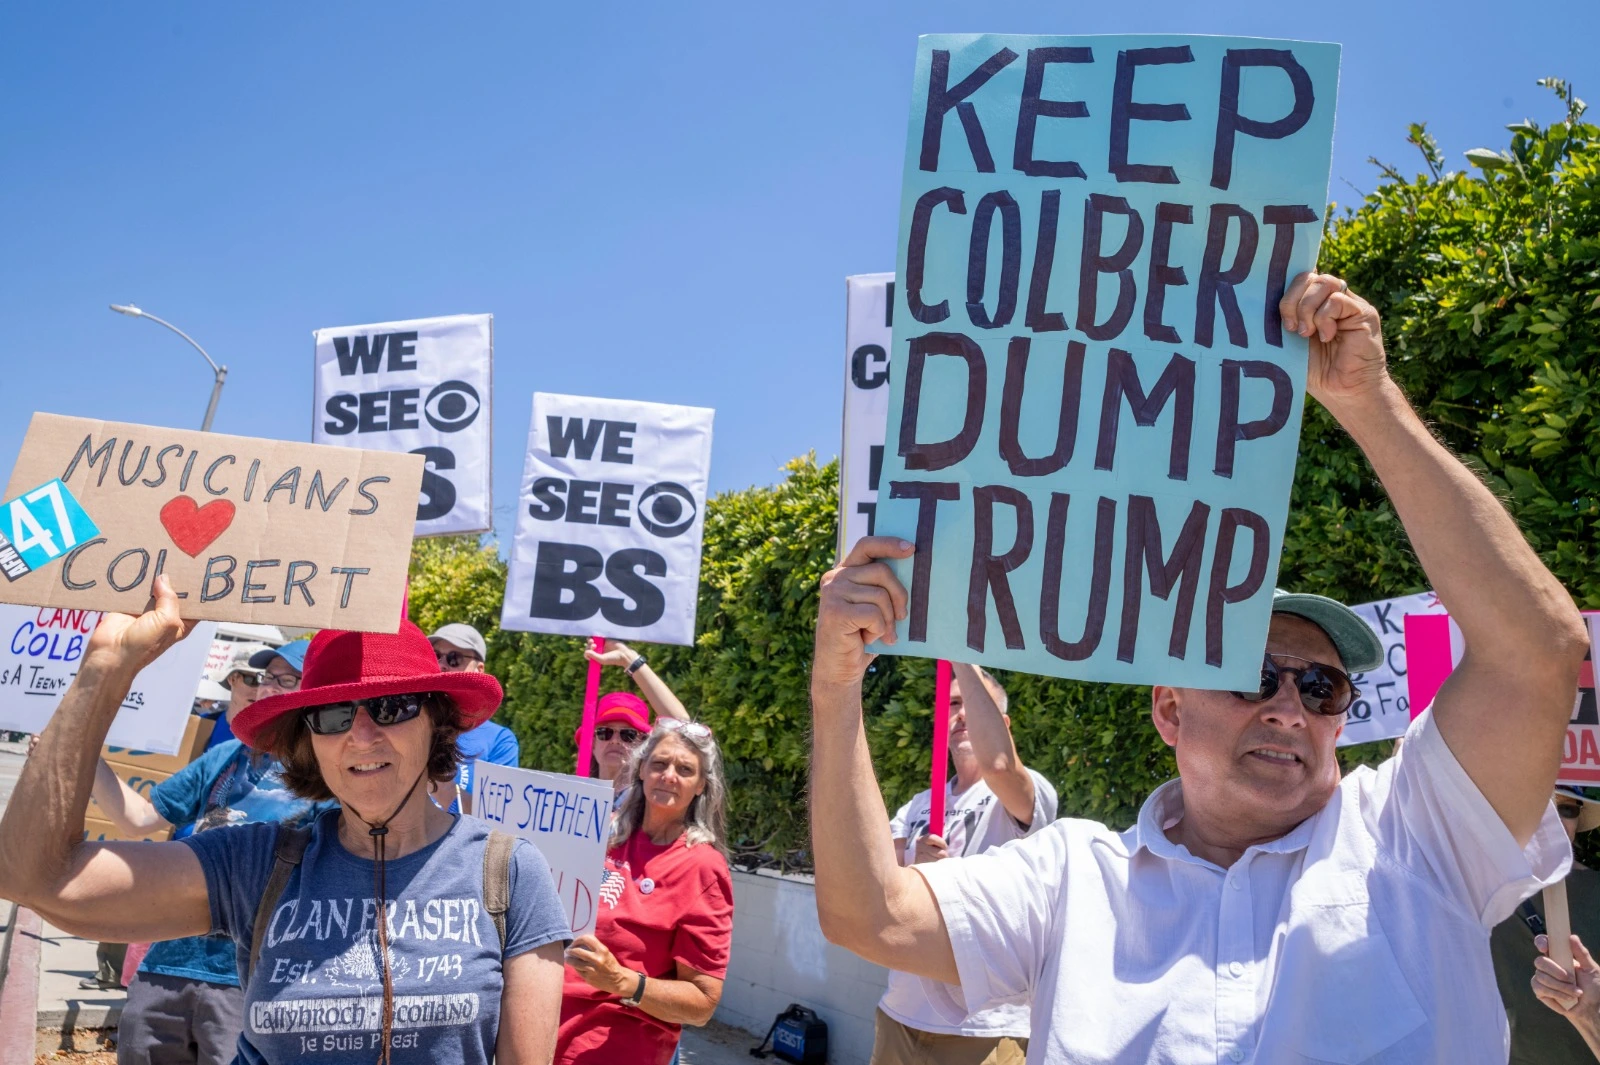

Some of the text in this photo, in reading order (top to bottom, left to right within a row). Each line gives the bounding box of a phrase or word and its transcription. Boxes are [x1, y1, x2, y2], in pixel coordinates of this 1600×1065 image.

[919, 46, 1315, 191] KEEP
[906, 186, 1319, 349] COLBERT
[332, 331, 418, 376] WE
[324, 388, 420, 436] SEE
[546, 416, 637, 465] WE
[897, 331, 1293, 482] DUMP
[61, 433, 391, 516] MUSICIANS
[415, 446, 457, 521] S
[528, 478, 634, 528] SEE
[9, 480, 77, 558] 47
[62, 537, 371, 609] COLBERT
[529, 541, 667, 628] BS
[889, 481, 1270, 669] TRUMP
[36, 607, 103, 634] CANC
[10, 664, 22, 686] A
[477, 775, 609, 843] KEEP STEPHEN
[267, 898, 354, 948] CLAN
[268, 954, 463, 985] Est. 1743
[299, 1031, 420, 1055] Je Suis Pest
